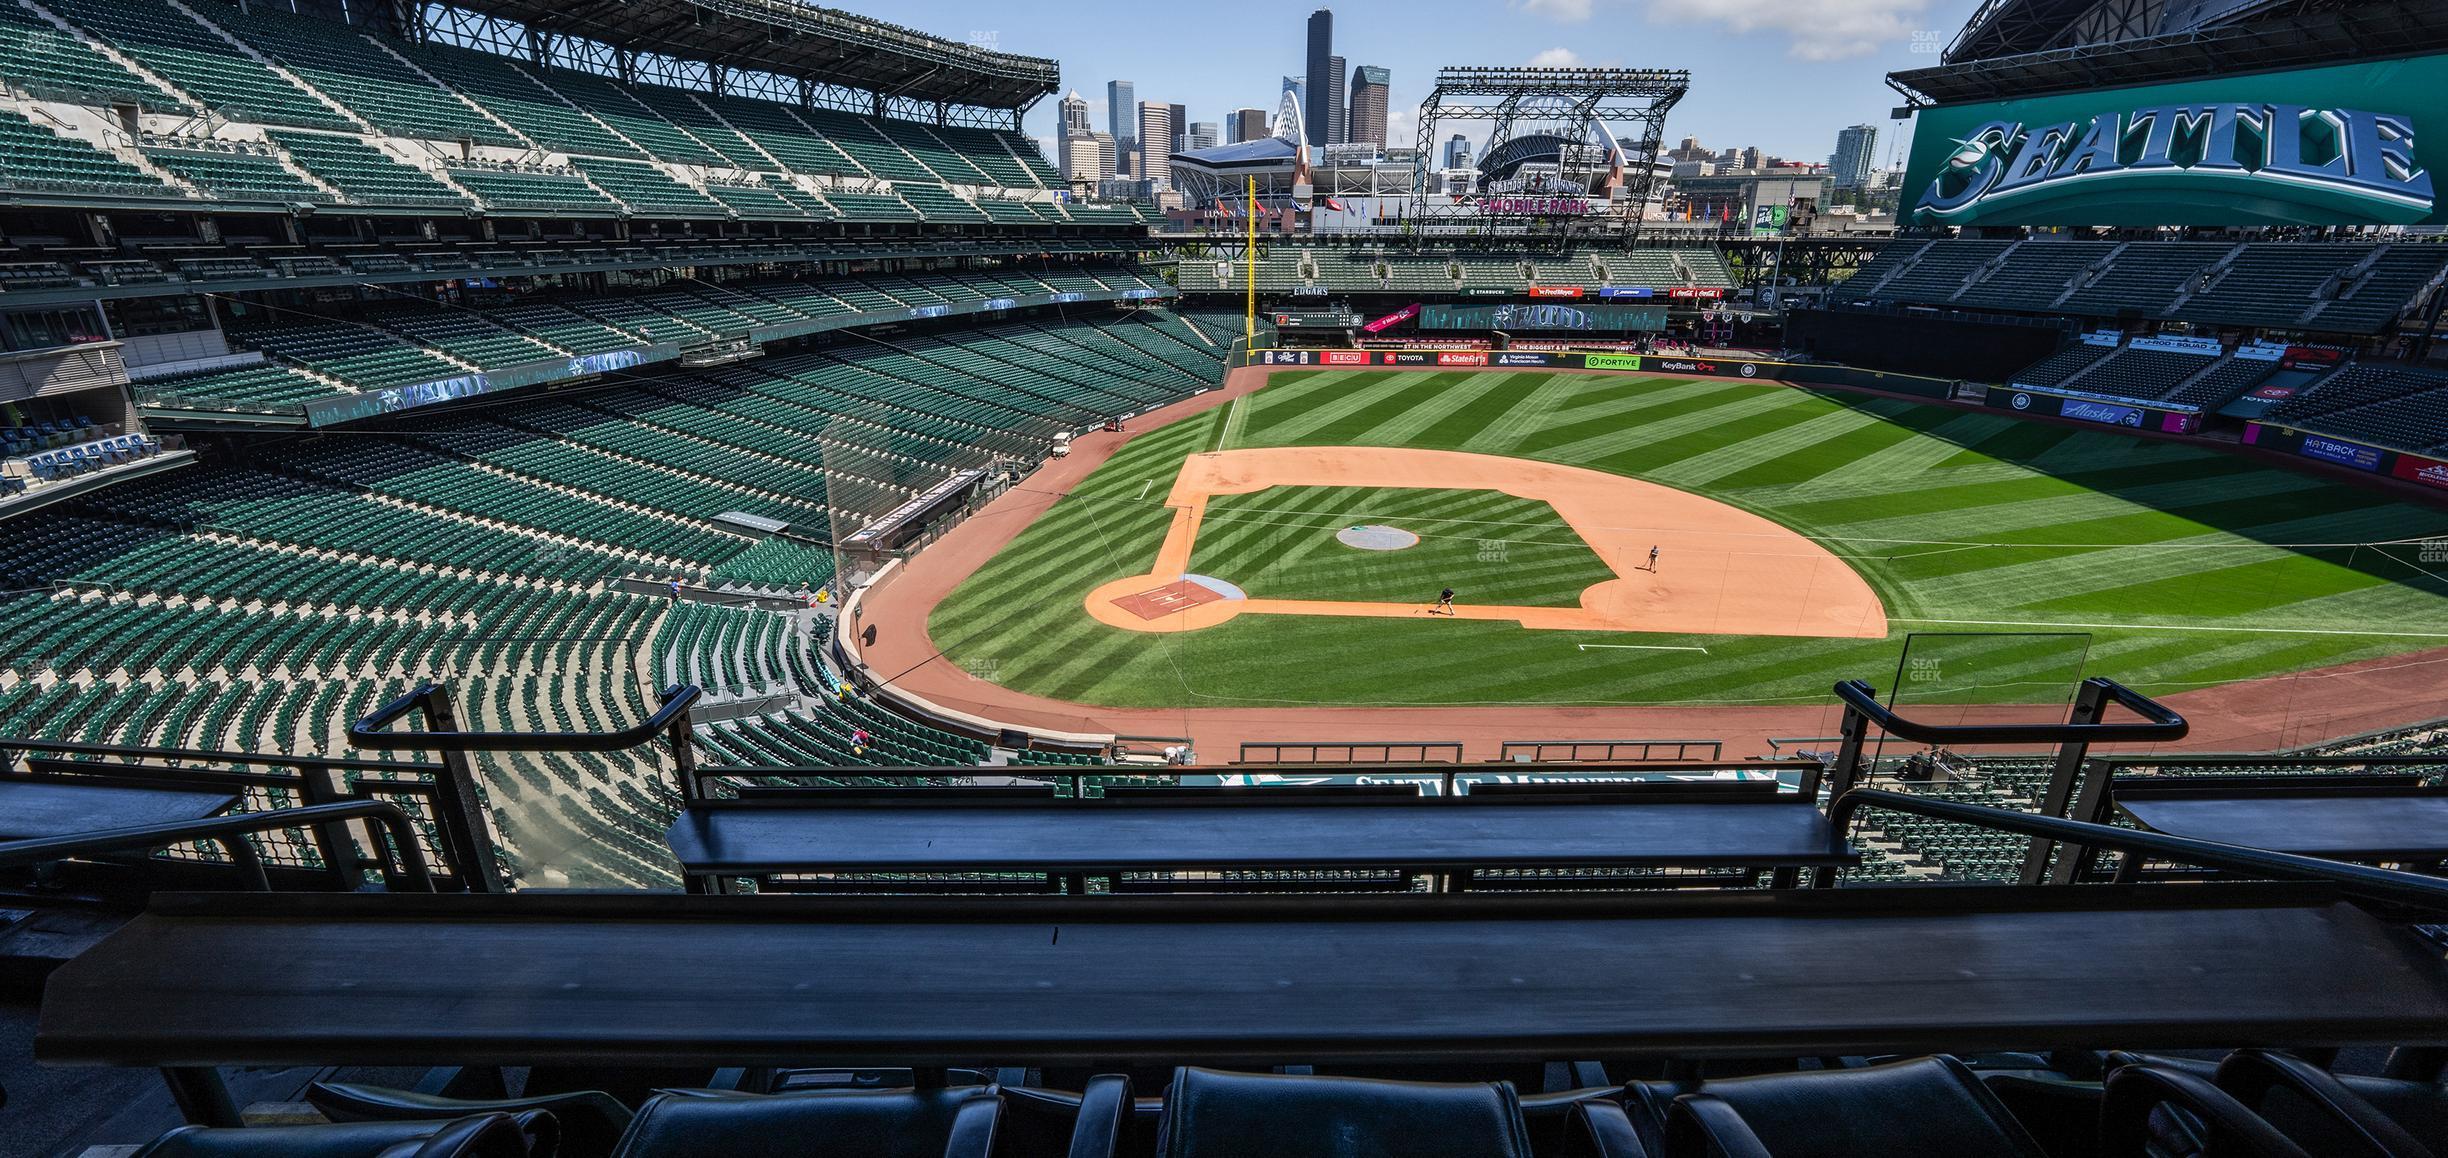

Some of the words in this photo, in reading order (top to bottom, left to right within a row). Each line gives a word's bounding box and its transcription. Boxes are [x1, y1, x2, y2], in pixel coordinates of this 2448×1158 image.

[1913, 102, 2435, 223] SEATTLE
[1549, 197, 1590, 213] PARK
[1332, 353, 1360, 361] BECU
[1600, 358, 1637, 367] FORTIVE
[1661, 361, 1696, 371] KeyBank
[2066, 403, 2115, 421] Alaska
[2304, 438, 2357, 458] HATBACK
